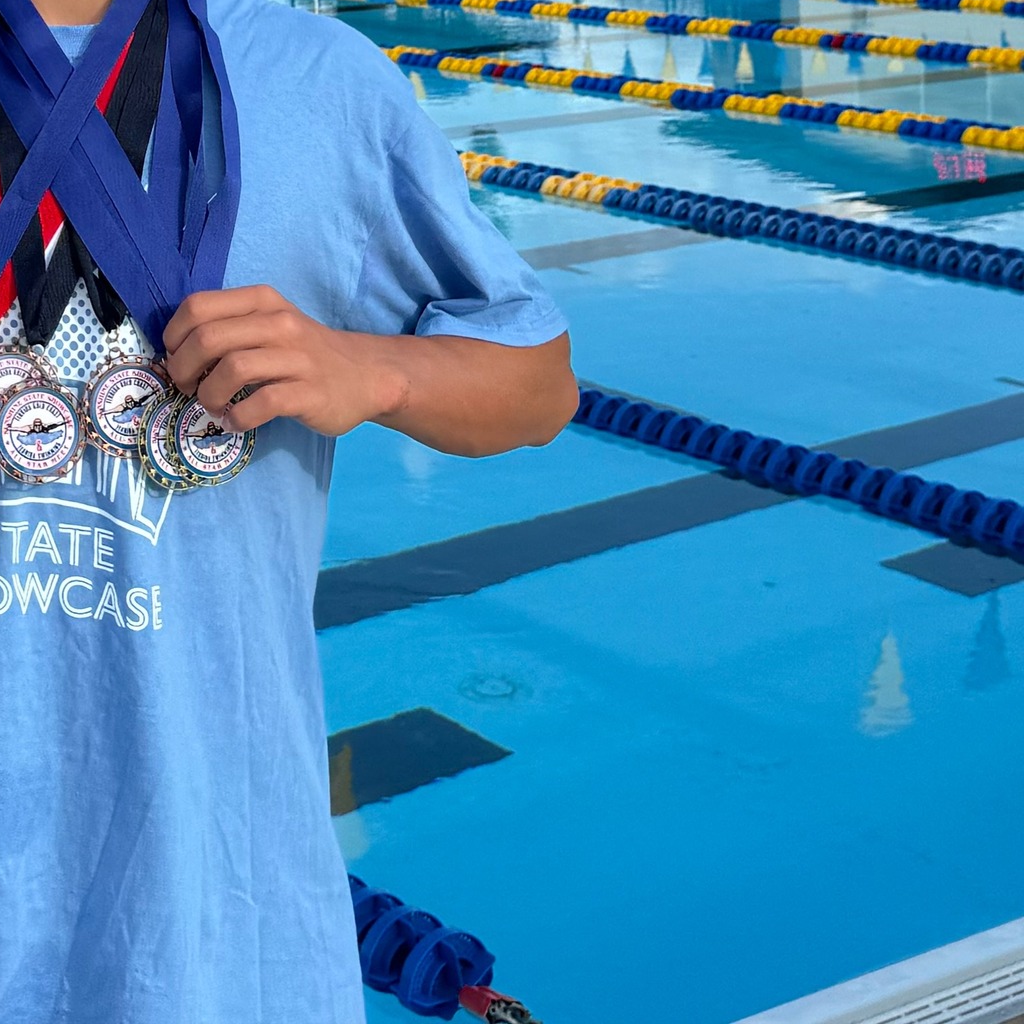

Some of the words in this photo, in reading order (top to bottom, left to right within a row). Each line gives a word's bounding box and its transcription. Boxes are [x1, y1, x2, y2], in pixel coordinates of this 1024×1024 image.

[109, 371, 130, 383] STATE
[23, 393, 44, 401] STATE
[51, 445, 69, 464] MEET
